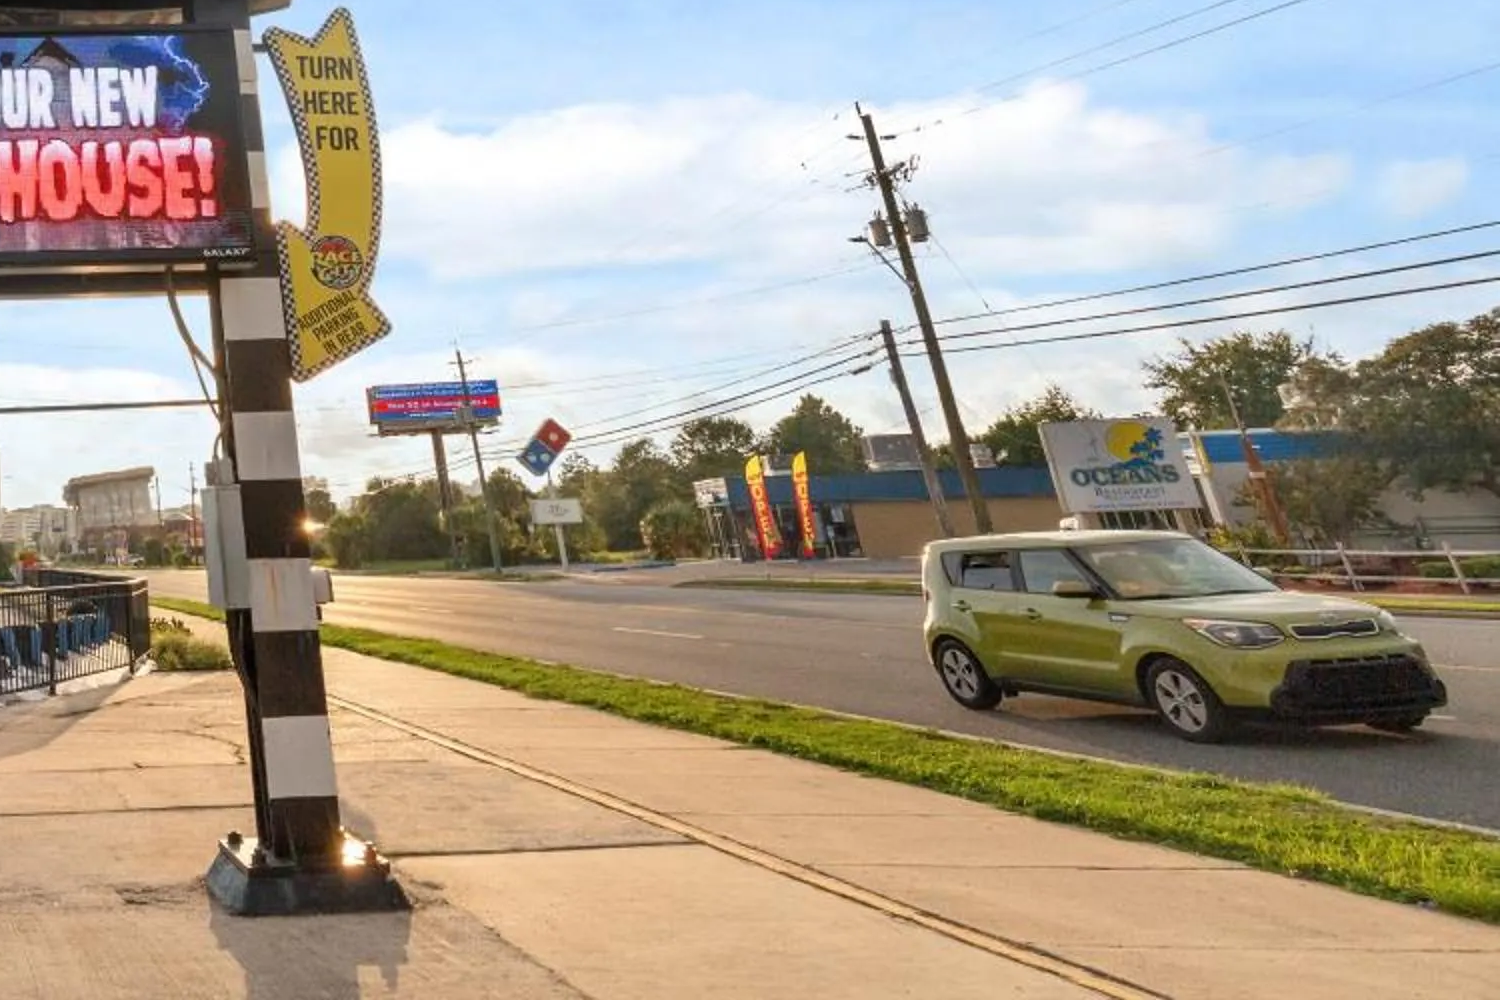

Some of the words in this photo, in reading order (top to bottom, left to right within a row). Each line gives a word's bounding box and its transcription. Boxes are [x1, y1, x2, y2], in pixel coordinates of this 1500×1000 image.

[296, 55, 354, 81] TURN
[70, 65, 160, 130] NEW
[303, 90, 360, 116] HERE
[316, 124, 360, 151] FOR
[203, 247, 251, 257] GALAXY
[300, 290, 357, 331] ADDITIONAL
[311, 306, 359, 342] PARKING
[1071, 464, 1180, 487] OCEANS
